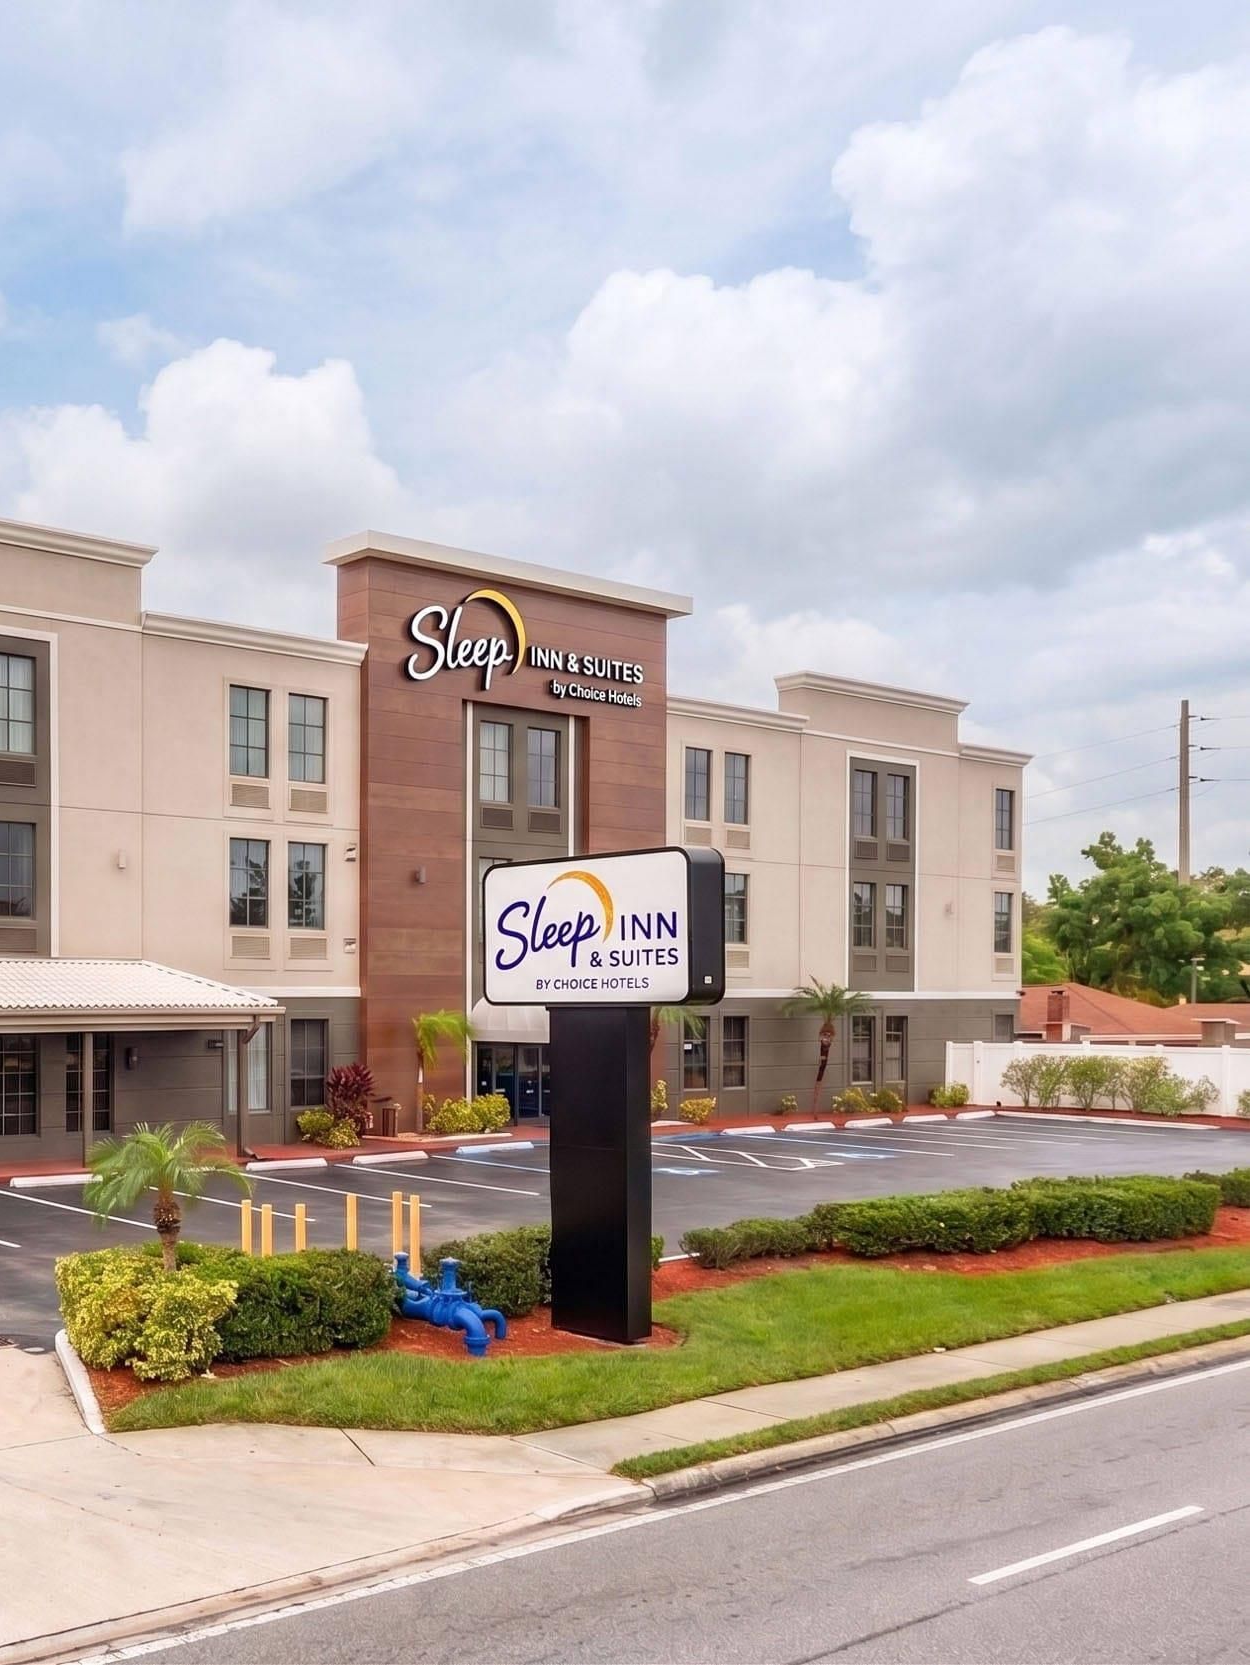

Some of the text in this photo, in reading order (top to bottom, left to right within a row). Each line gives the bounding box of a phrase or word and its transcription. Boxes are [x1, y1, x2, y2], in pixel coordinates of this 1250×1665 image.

[407, 605, 644, 690] Sleep INN & SUITES
[553, 680, 642, 708] by Choice Hotels
[495, 895, 677, 970] Sleep INN
[589, 948, 679, 968] & SUITES
[536, 977, 650, 990] BY CHOICE HOTELS
